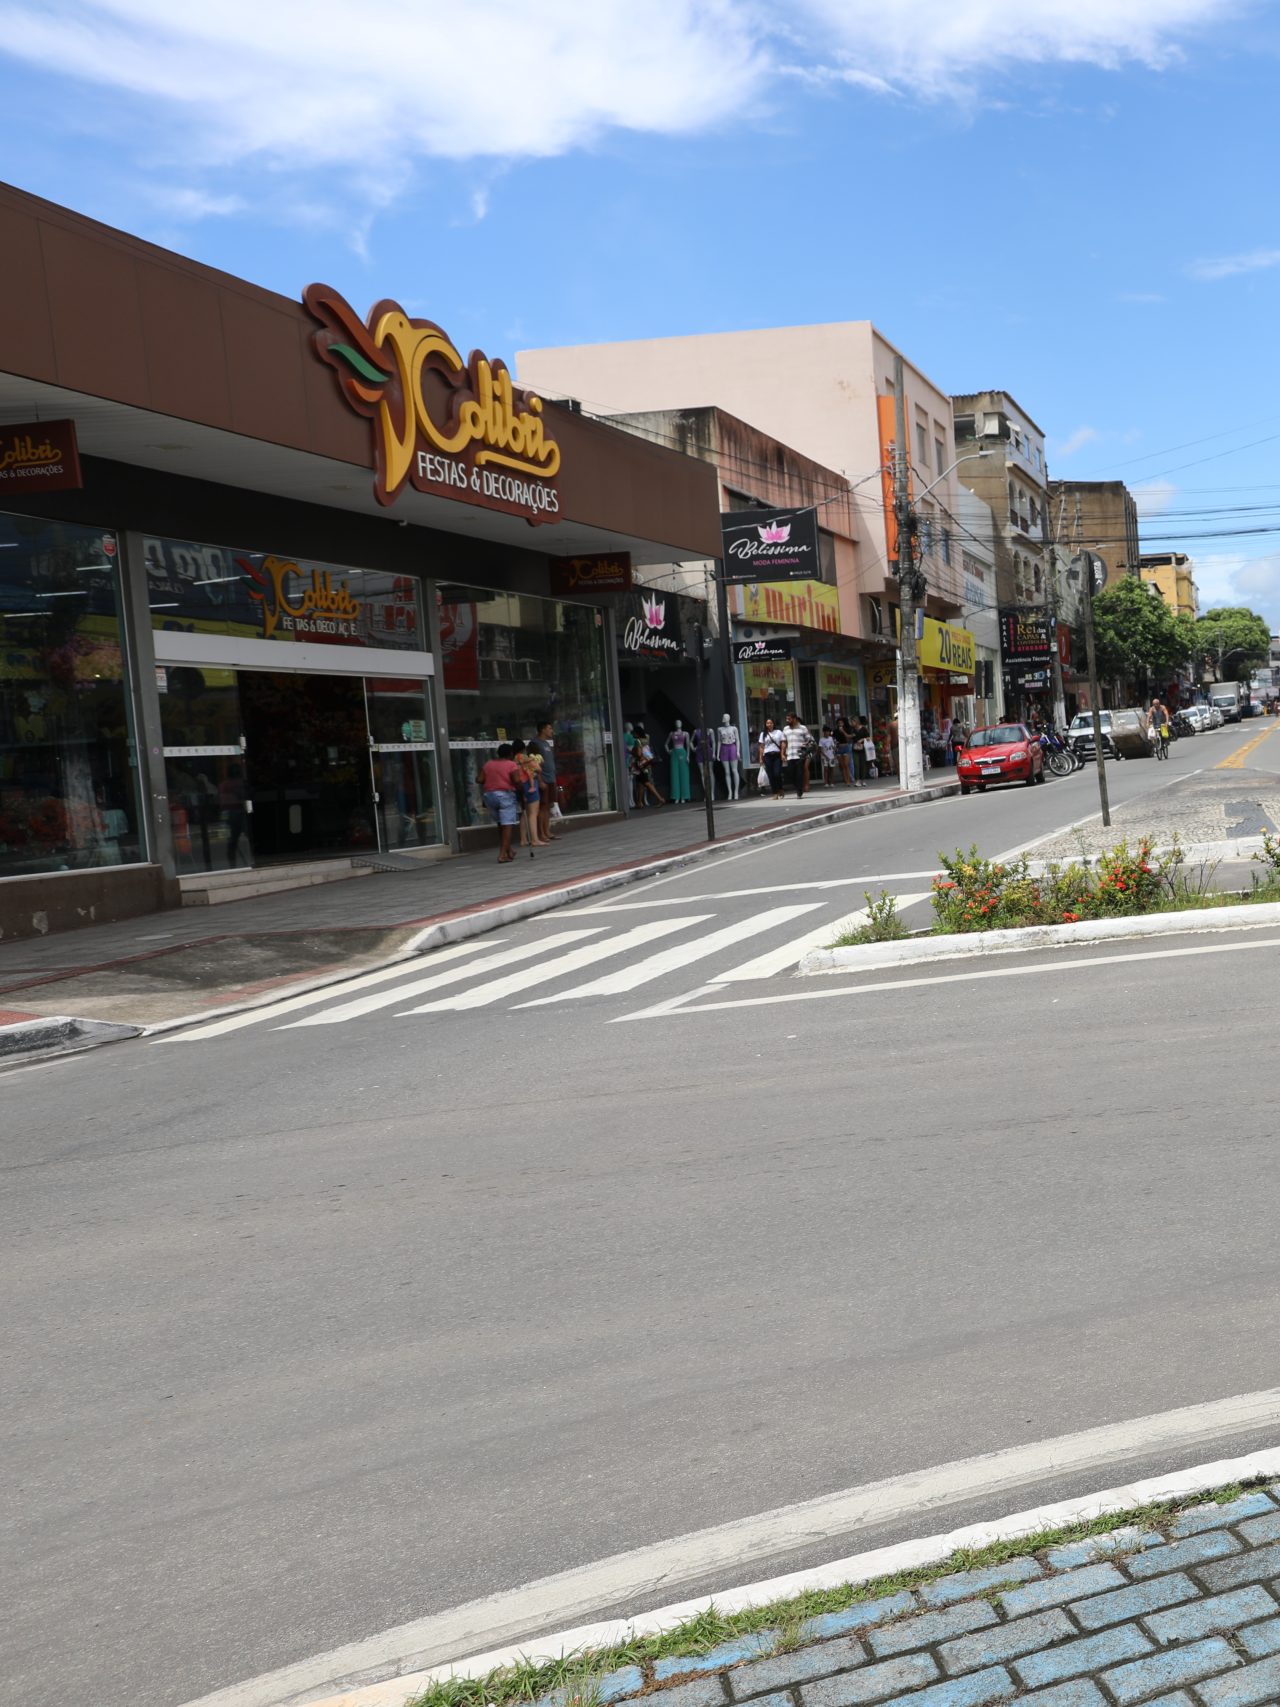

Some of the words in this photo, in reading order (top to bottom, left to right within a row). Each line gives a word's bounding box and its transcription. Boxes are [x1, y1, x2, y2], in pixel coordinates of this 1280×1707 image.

[412, 335, 560, 478] Colibri
[0, 435, 62, 469] olibri
[16, 464, 64, 478] DECORAÇÕES
[417, 450, 468, 489] FESTAS
[470, 467, 480, 493] &
[482, 470, 559, 514] DECORAÇÕES
[728, 538, 811, 559] Belissima
[772, 557, 800, 565] FEMININA
[280, 561, 361, 621] Colibri
[938, 626, 950, 664] 20
[952, 643, 972, 668] REAIS
